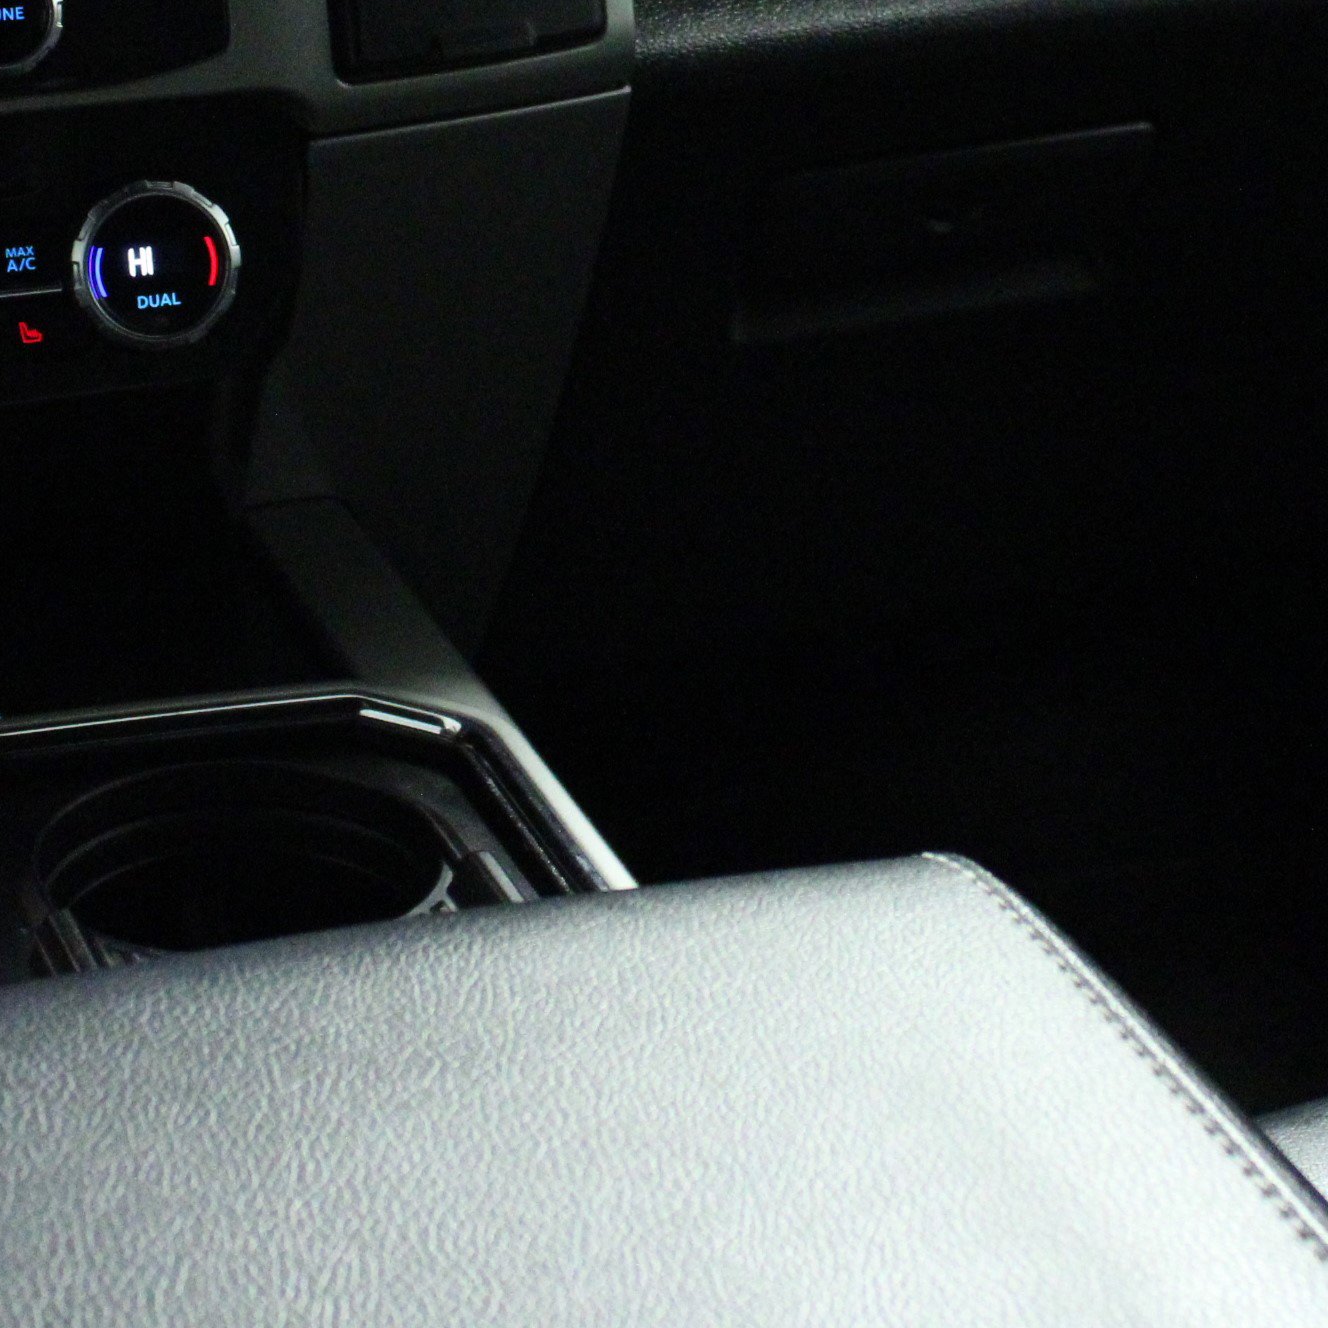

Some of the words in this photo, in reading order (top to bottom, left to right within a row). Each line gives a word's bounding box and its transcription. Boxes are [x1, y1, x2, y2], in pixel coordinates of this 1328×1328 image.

[5, 245, 35, 258] MAX
[7, 256, 36, 272] A/C
[128, 246, 154, 277] HI
[137, 293, 181, 309] DUAL
